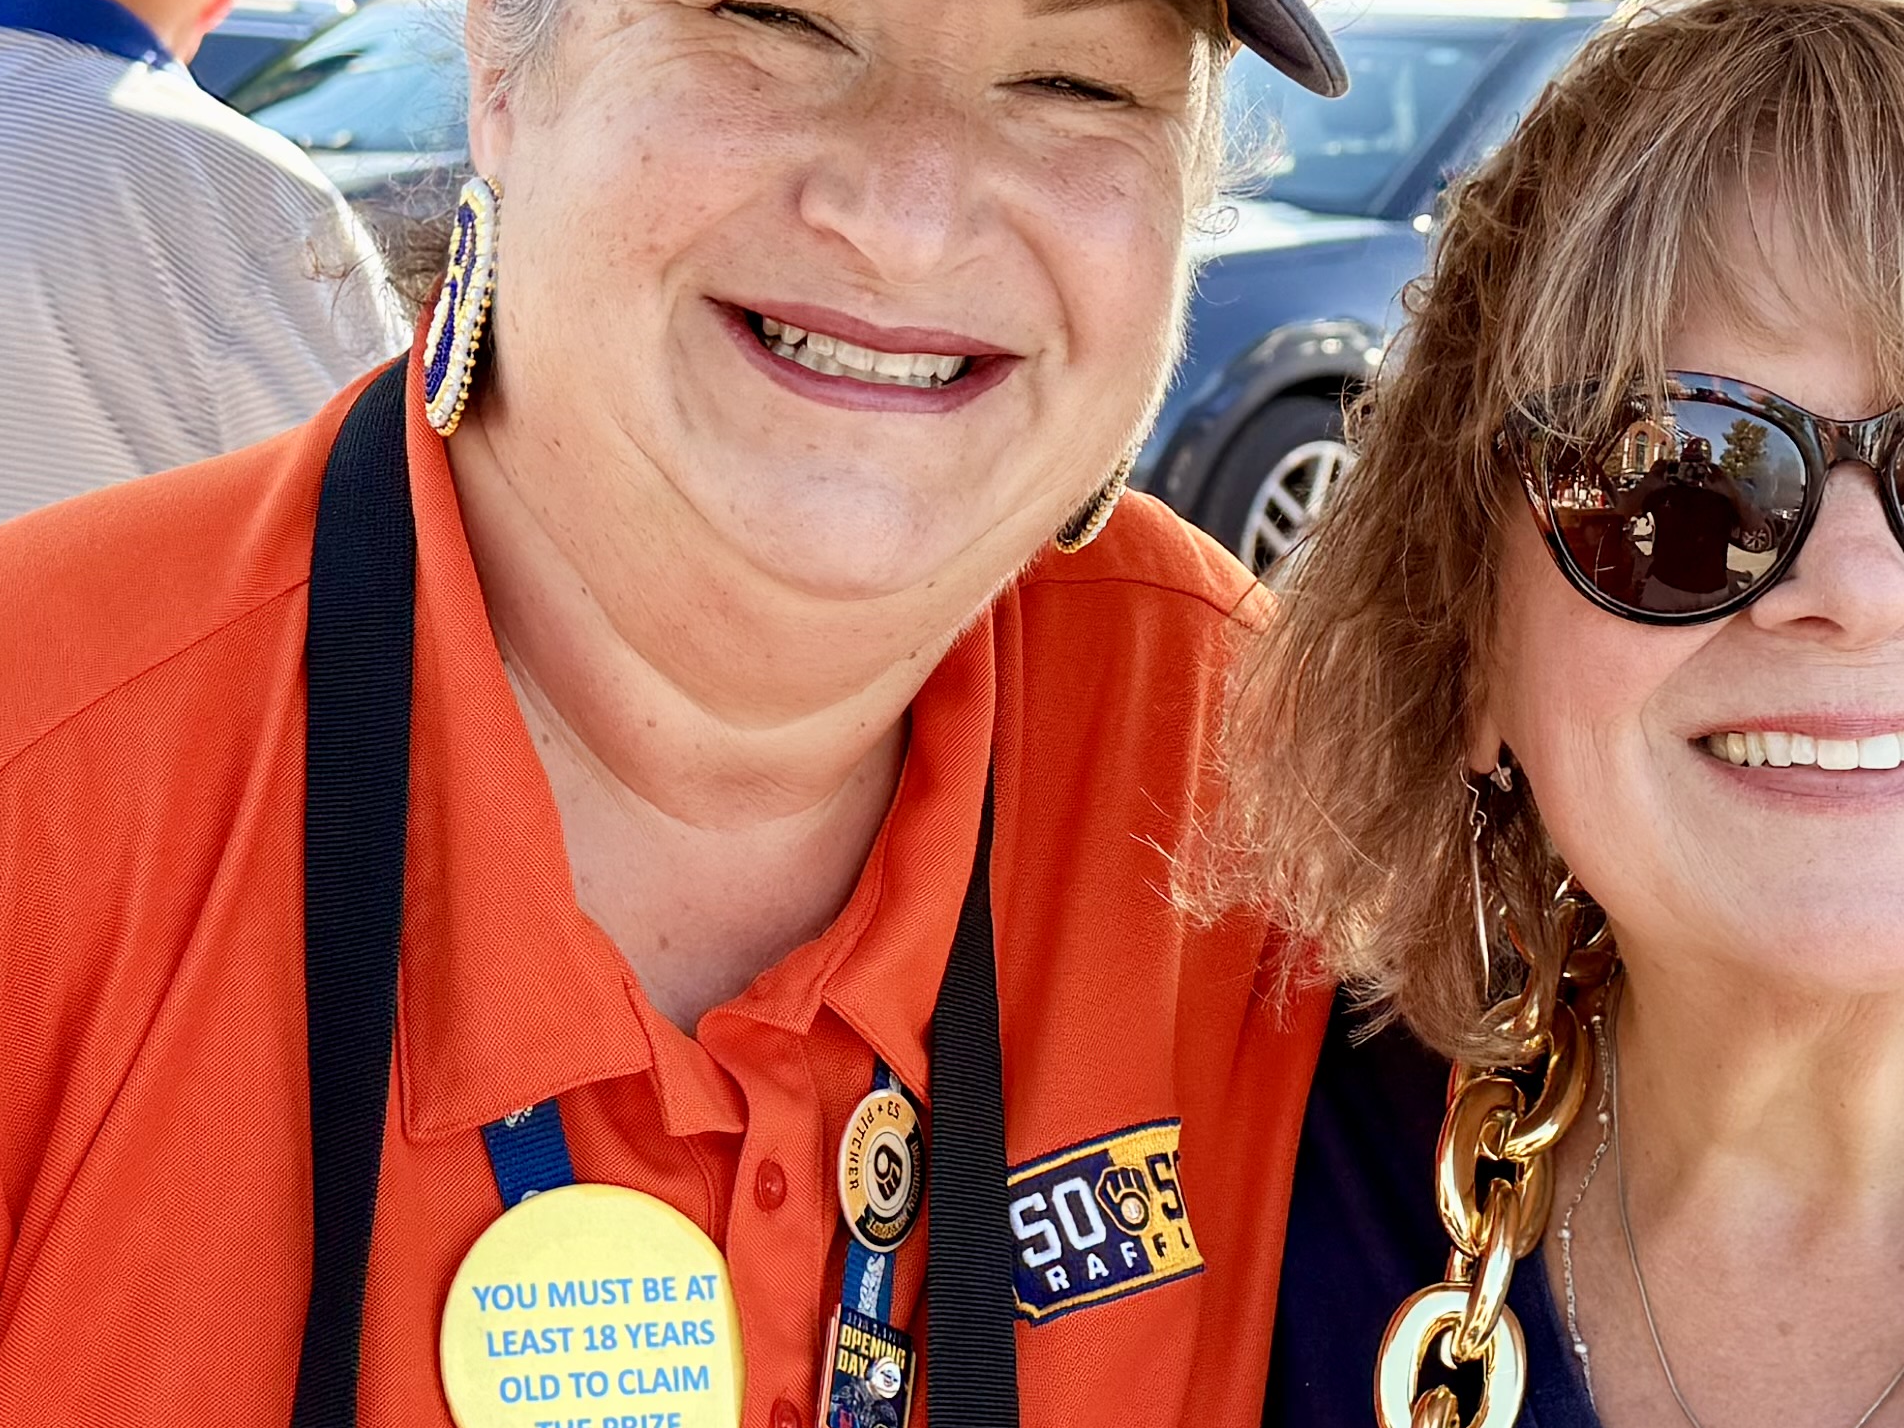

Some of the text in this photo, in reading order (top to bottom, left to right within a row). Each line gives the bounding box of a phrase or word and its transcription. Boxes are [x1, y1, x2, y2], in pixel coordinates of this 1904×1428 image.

[848, 1106, 875, 1191] PITCHER
[1009, 1177, 1106, 1268] 50
[1146, 1151, 1184, 1220] 5
[472, 1275, 717, 1311] YOU MUST BE AT
[486, 1320, 715, 1357] LEAST 18 YEARS
[840, 1324, 906, 1370] OPENING
[837, 1349, 868, 1377] DAY
[500, 1365, 709, 1403] OLD TO CLAIM
